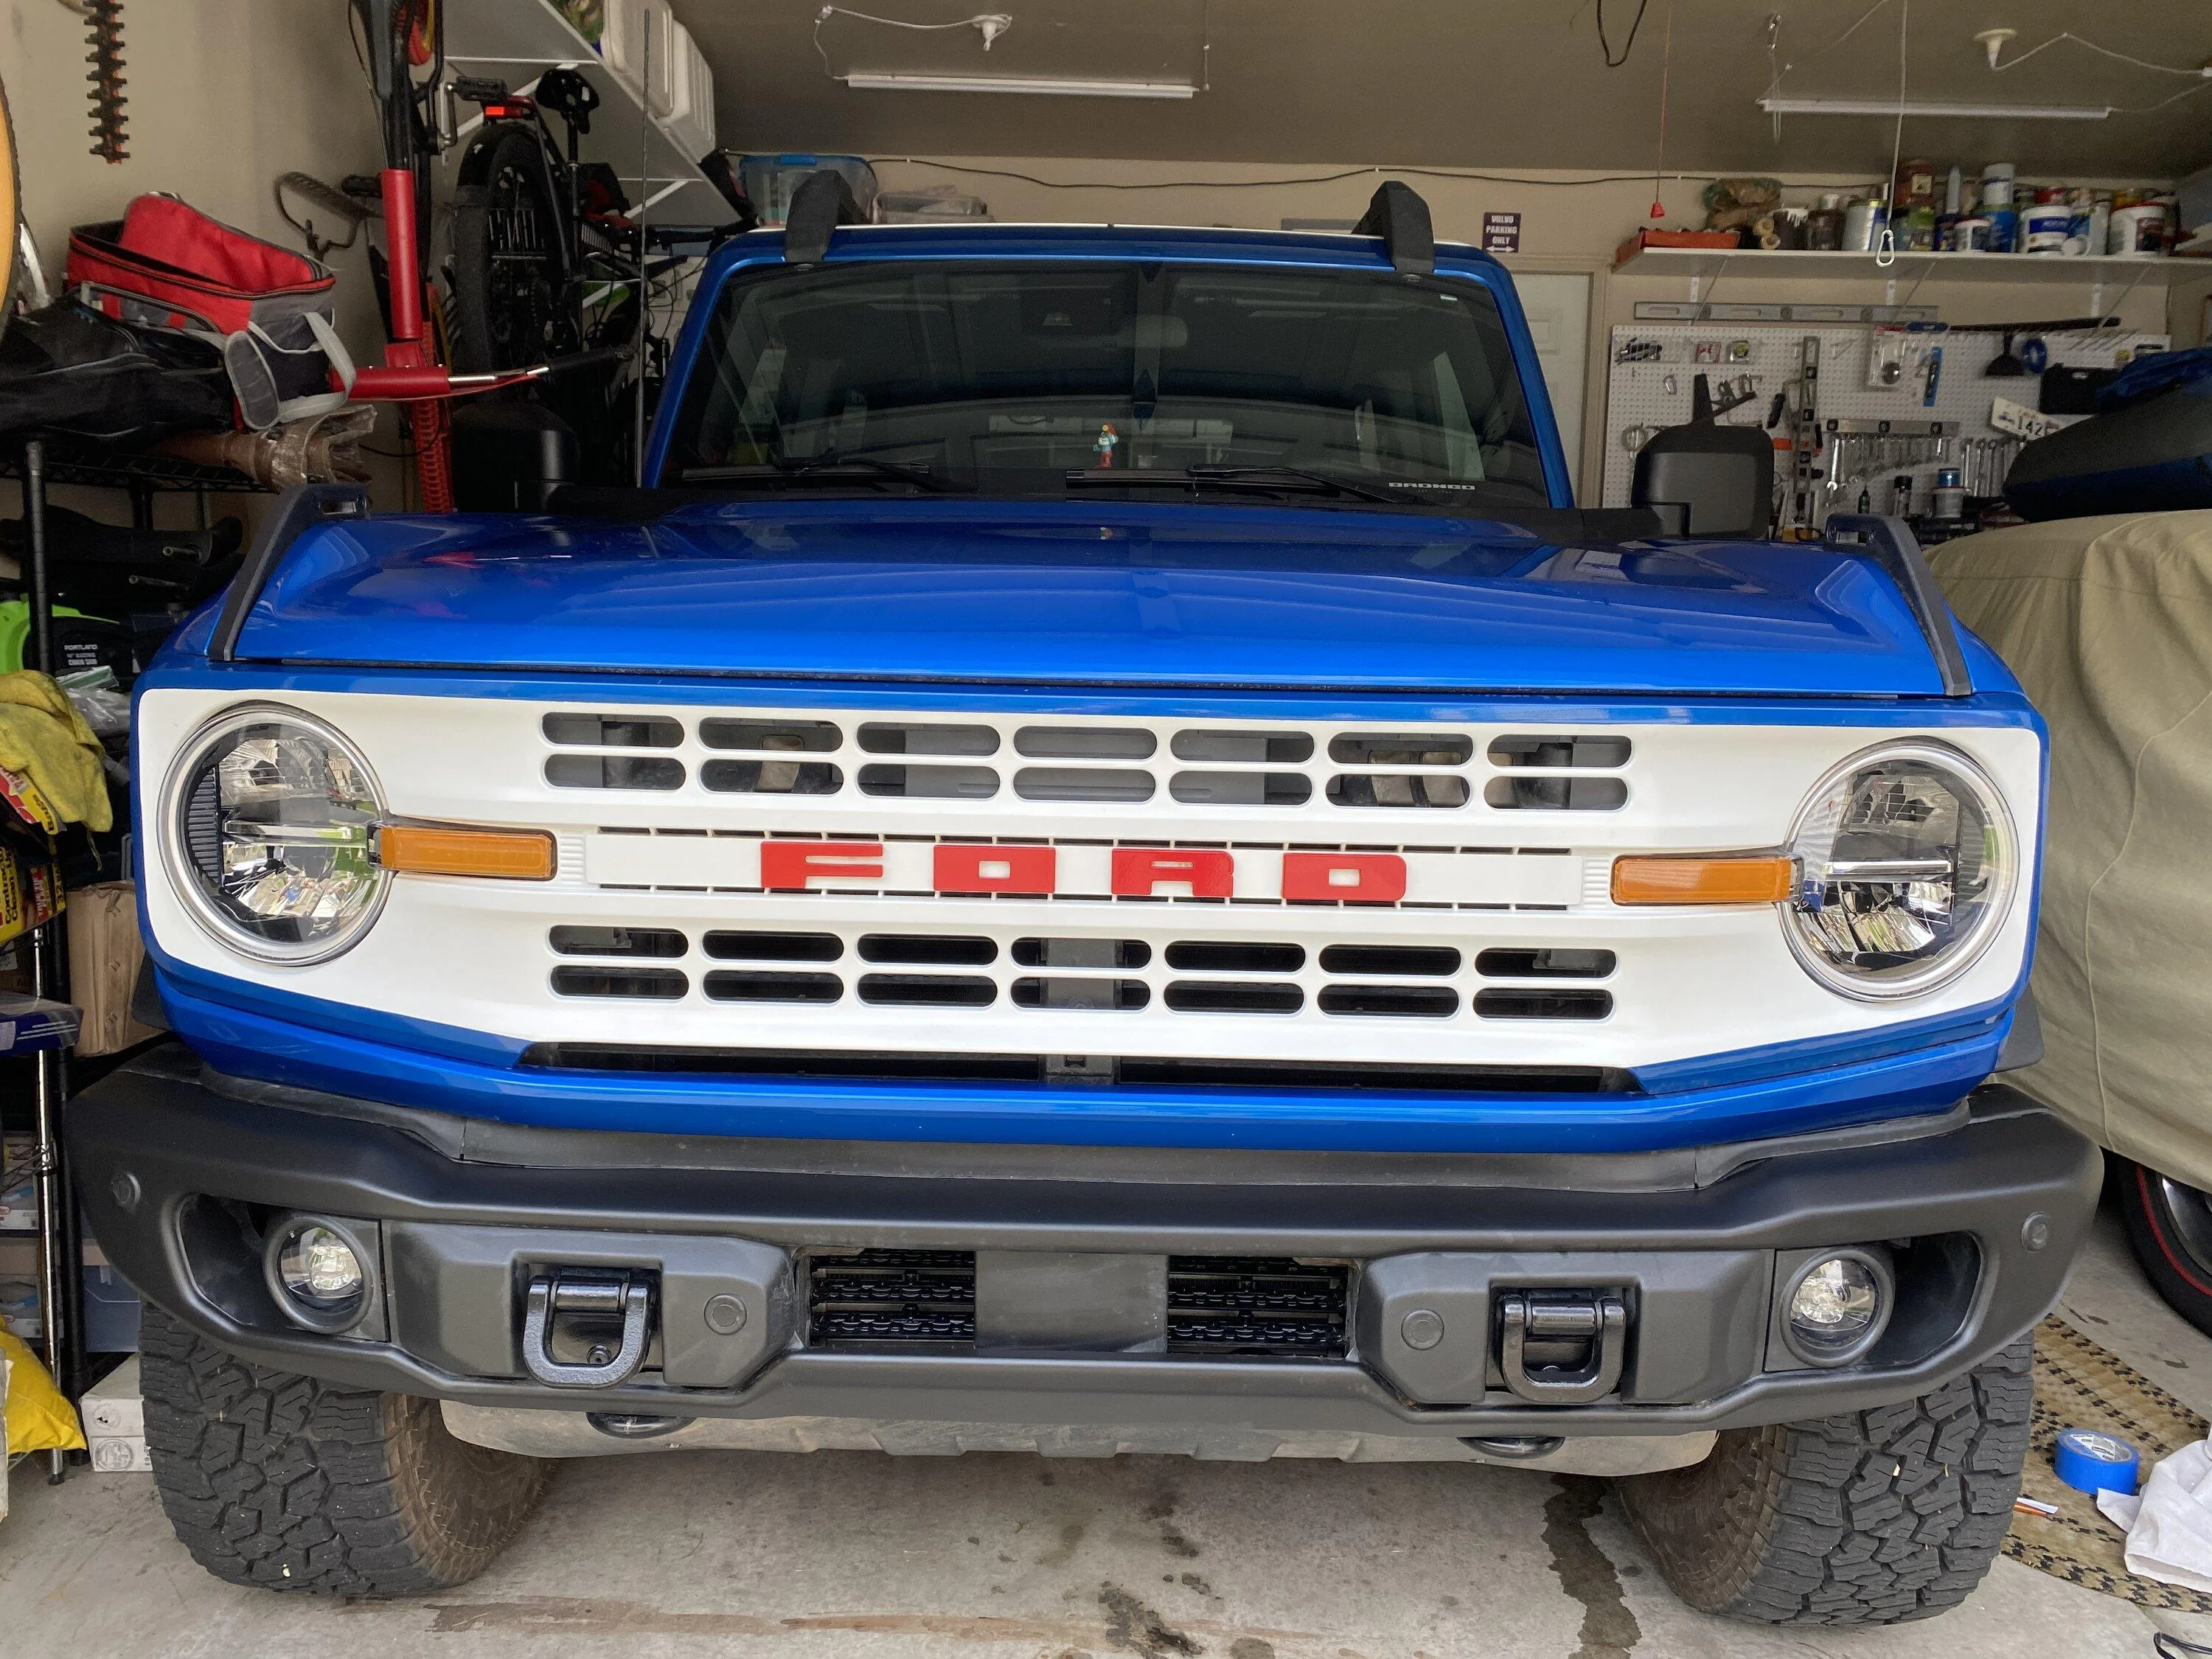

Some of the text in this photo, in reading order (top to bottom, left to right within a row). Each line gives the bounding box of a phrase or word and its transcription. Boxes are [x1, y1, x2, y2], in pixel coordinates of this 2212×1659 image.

[1491, 215, 1514, 223] VOLVO
[1486, 225, 1517, 234] PARKING
[1492, 236, 1511, 244] ONLY
[761, 842, 1407, 902] FORD
